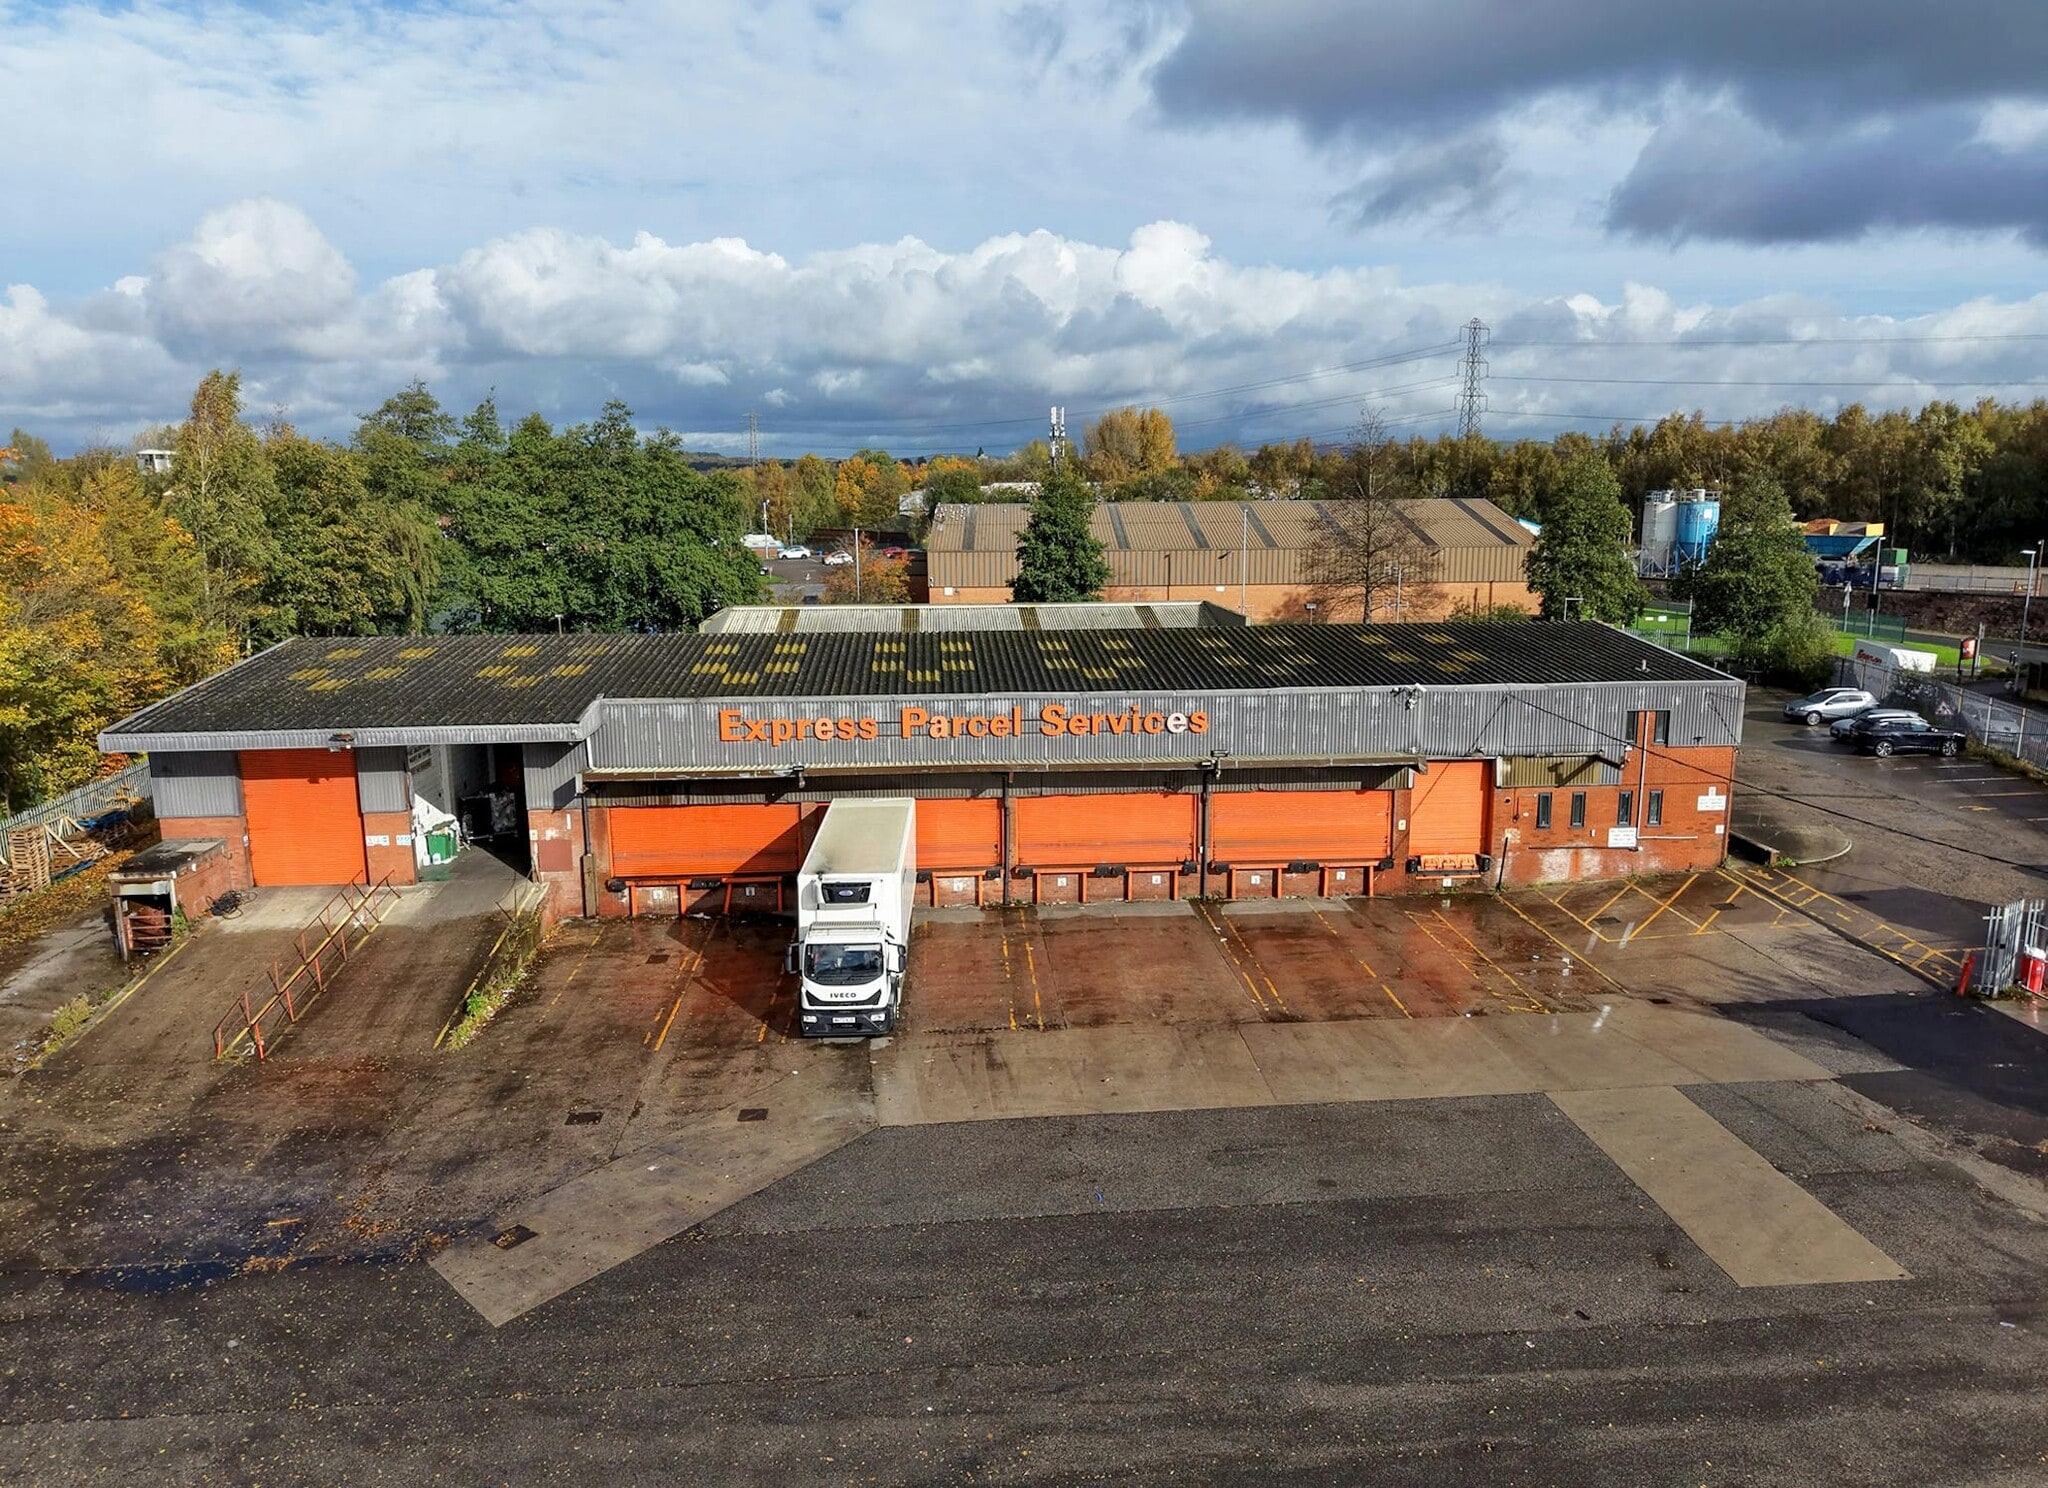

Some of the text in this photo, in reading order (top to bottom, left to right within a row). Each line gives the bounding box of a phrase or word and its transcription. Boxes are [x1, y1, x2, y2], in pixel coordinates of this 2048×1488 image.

[719, 701, 1209, 746] Express Parcel Services
